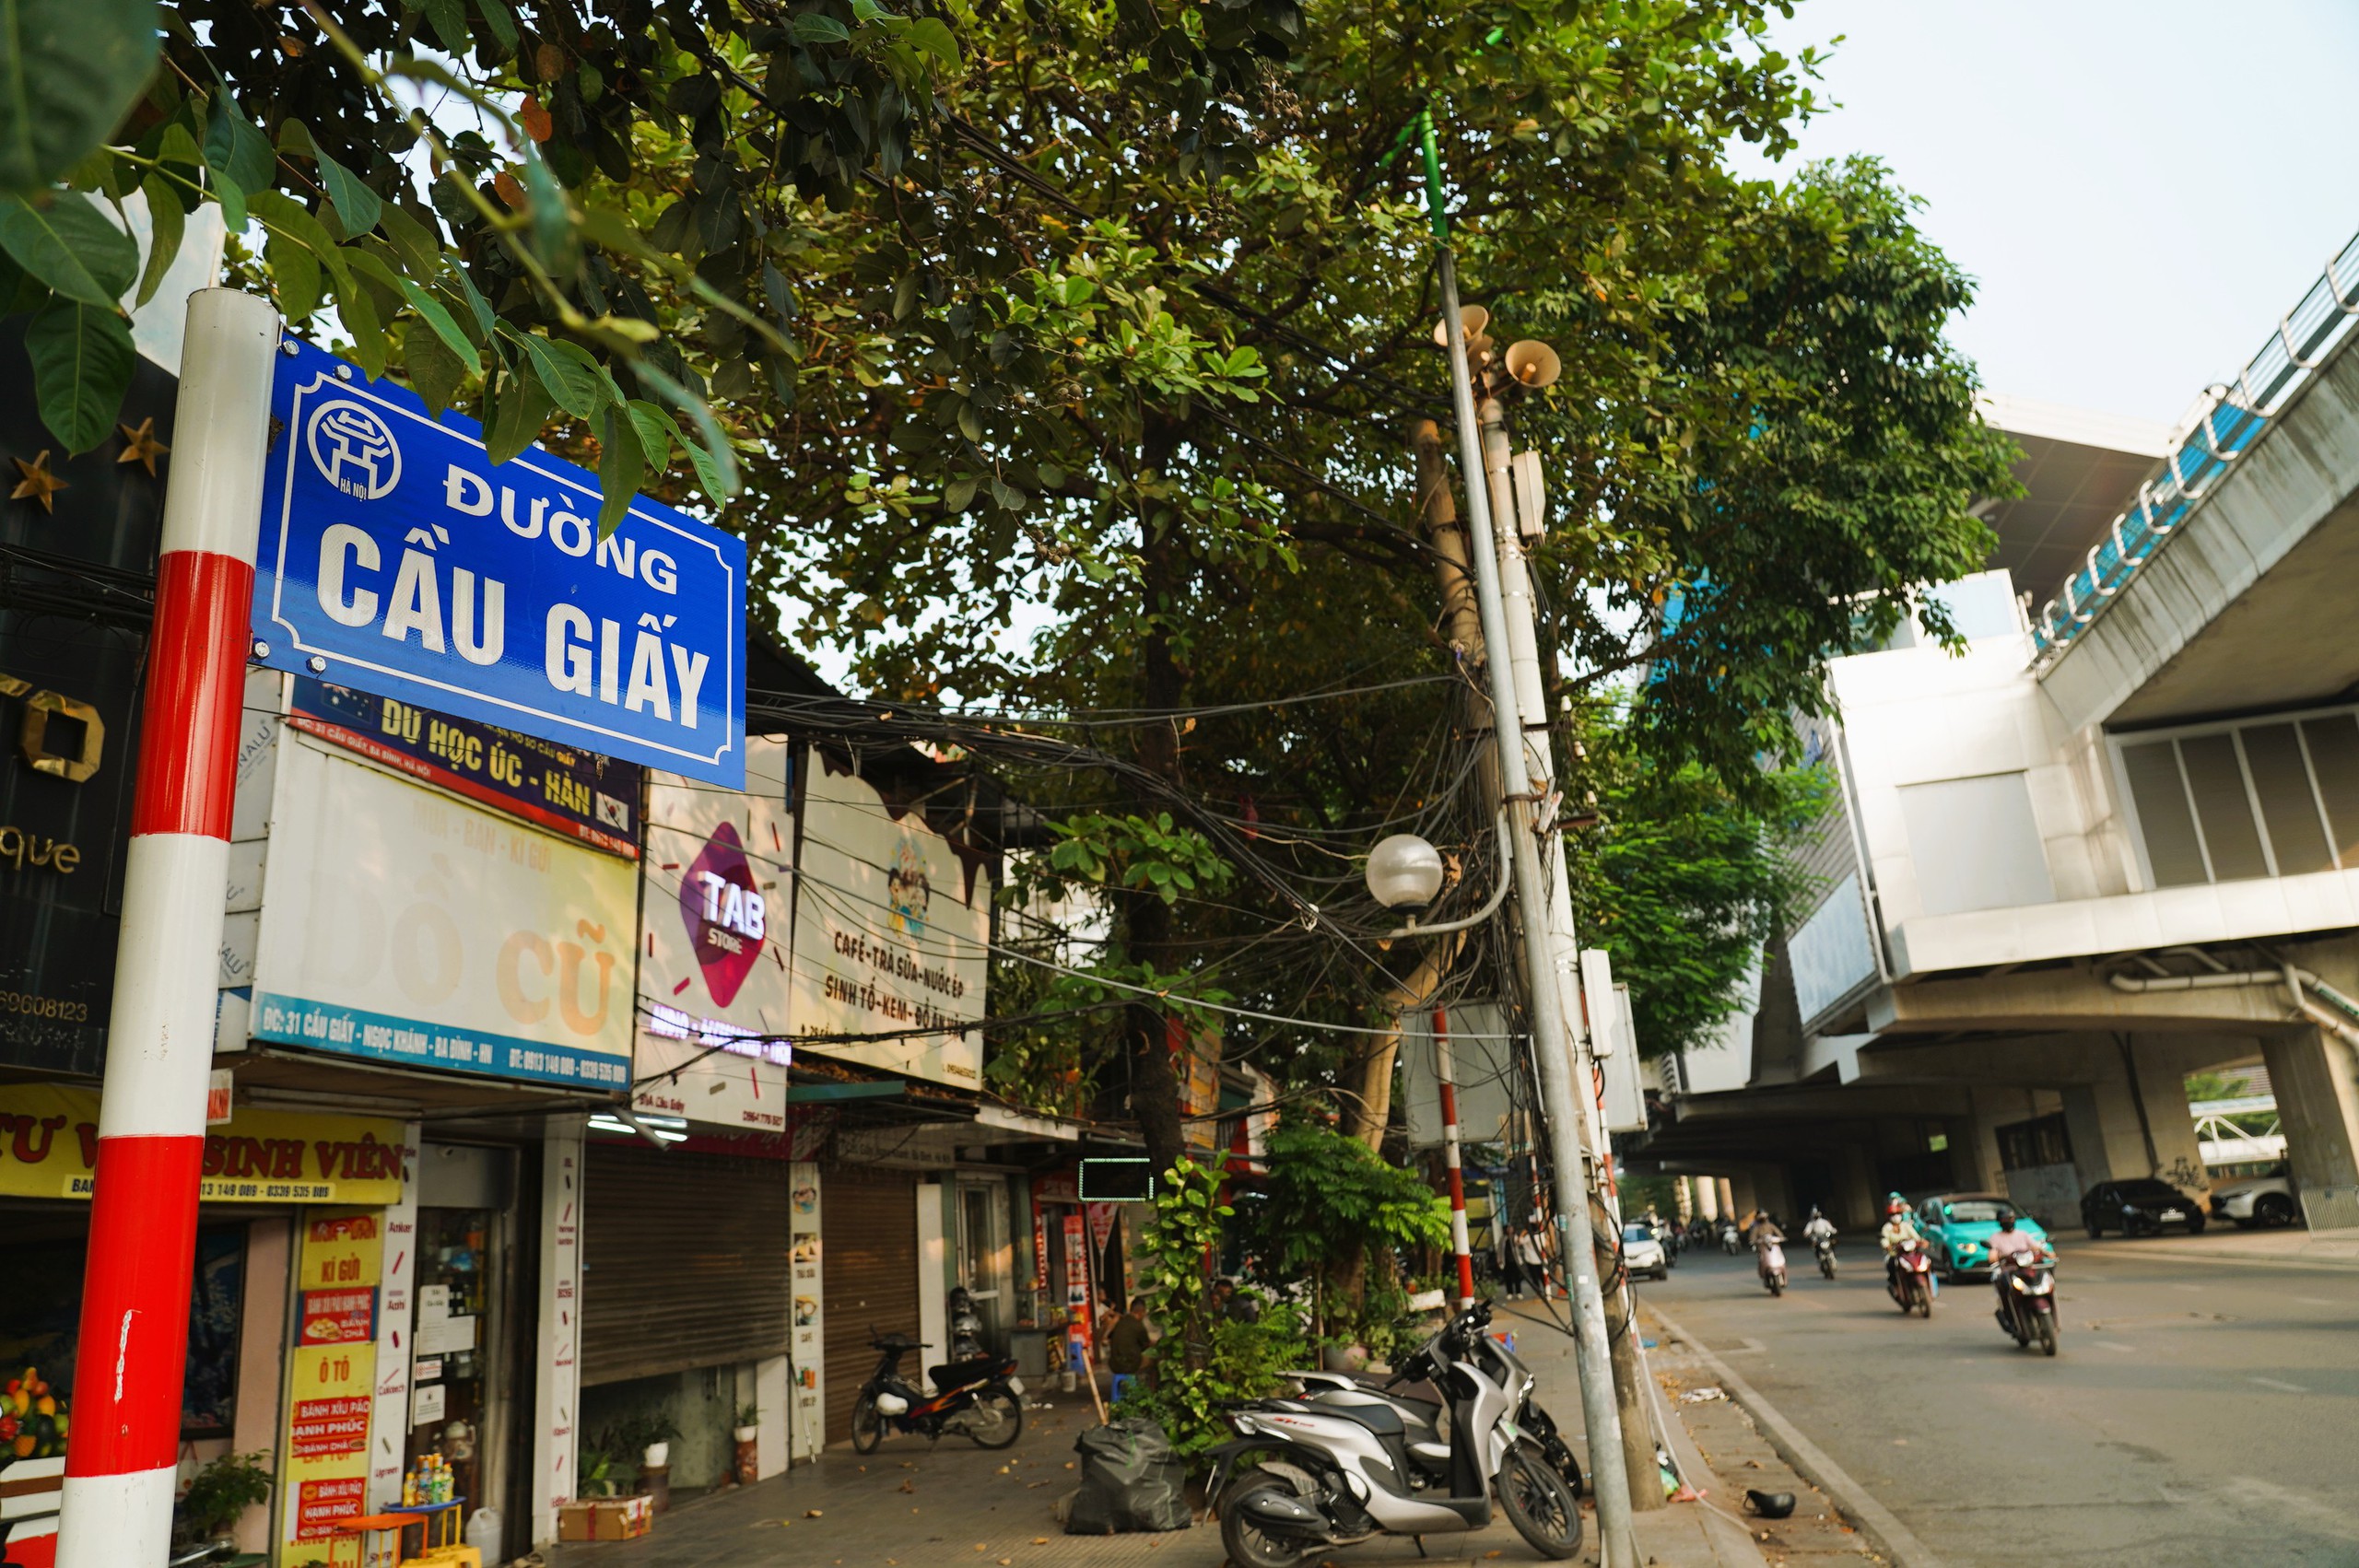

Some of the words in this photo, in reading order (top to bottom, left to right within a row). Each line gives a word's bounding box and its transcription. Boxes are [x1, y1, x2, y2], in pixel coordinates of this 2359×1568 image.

[340, 477, 350, 494] HÀ
[353, 482, 367, 502] NỘI
[442, 463, 677, 595] ĐƯỜNG
[317, 523, 506, 666] CẦU
[546, 603, 710, 730] GIẤY
[428, 718, 484, 770] HỌC
[489, 741, 522, 788] ÚC
[545, 768, 591, 816] HÀN
[698, 871, 766, 941] TAB
[707, 927, 743, 955] STORE
[496, 918, 616, 1036] CŨ
[825, 975, 857, 1006] SINH
[286, 1011, 300, 1035] 31
[303, 1007, 328, 1038] CẦU
[329, 1012, 356, 1043] GIẤY
[363, 1024, 393, 1053] NGỌC
[393, 1027, 428, 1056] KHÁNH
[202, 1134, 306, 1179] SINH
[314, 1131, 405, 1180] VIÊN
[327, 1418, 365, 1433] PHÚC
